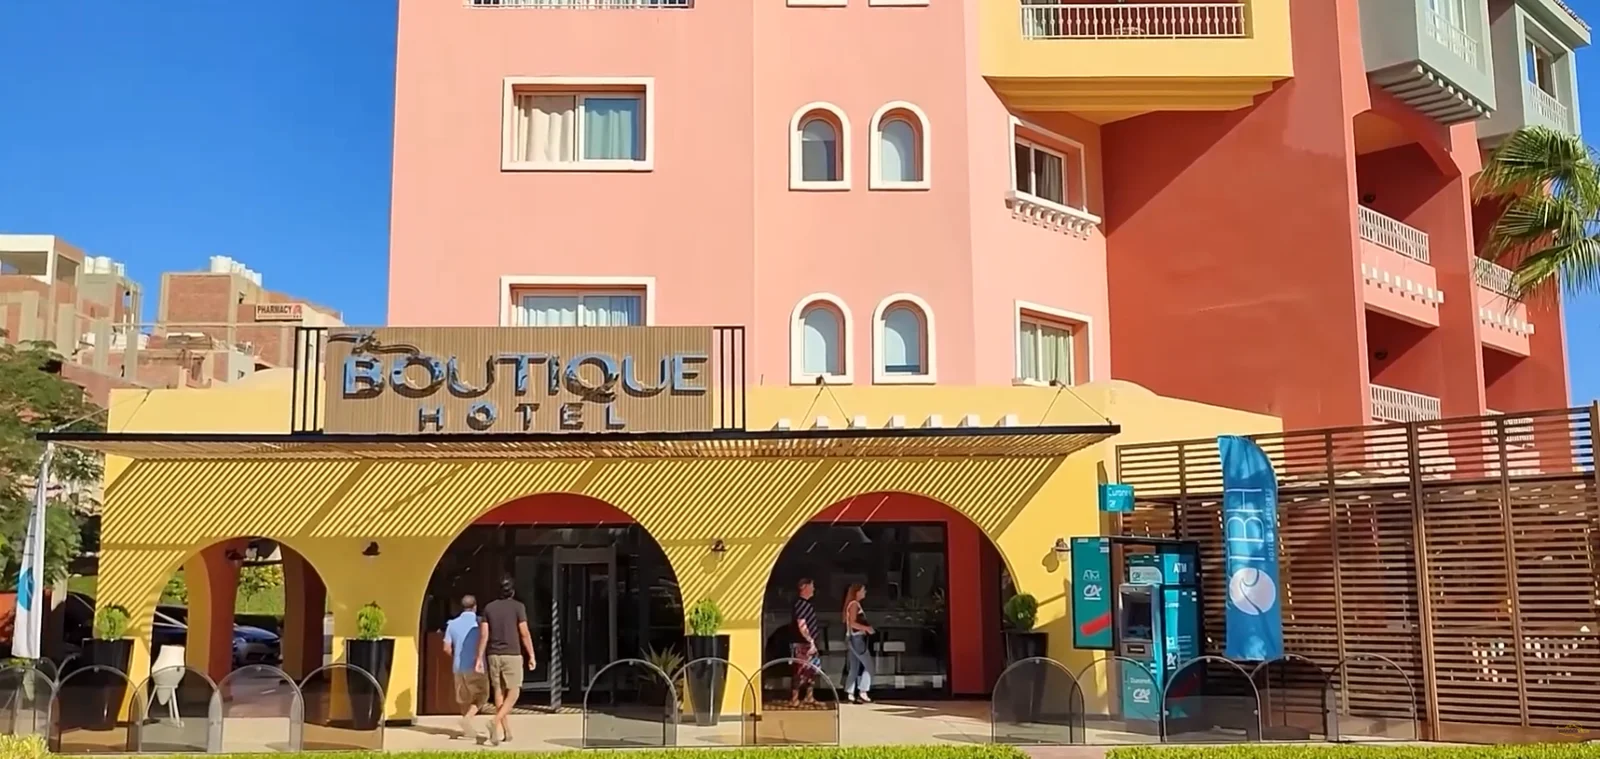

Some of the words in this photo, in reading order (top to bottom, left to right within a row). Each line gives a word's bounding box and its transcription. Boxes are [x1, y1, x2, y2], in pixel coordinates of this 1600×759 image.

[257, 305, 292, 314] PHARMACY
[343, 353, 708, 403] BOUTIQUE
[418, 402, 626, 432] HOTEL
[1173, 562, 1187, 573] ATM
